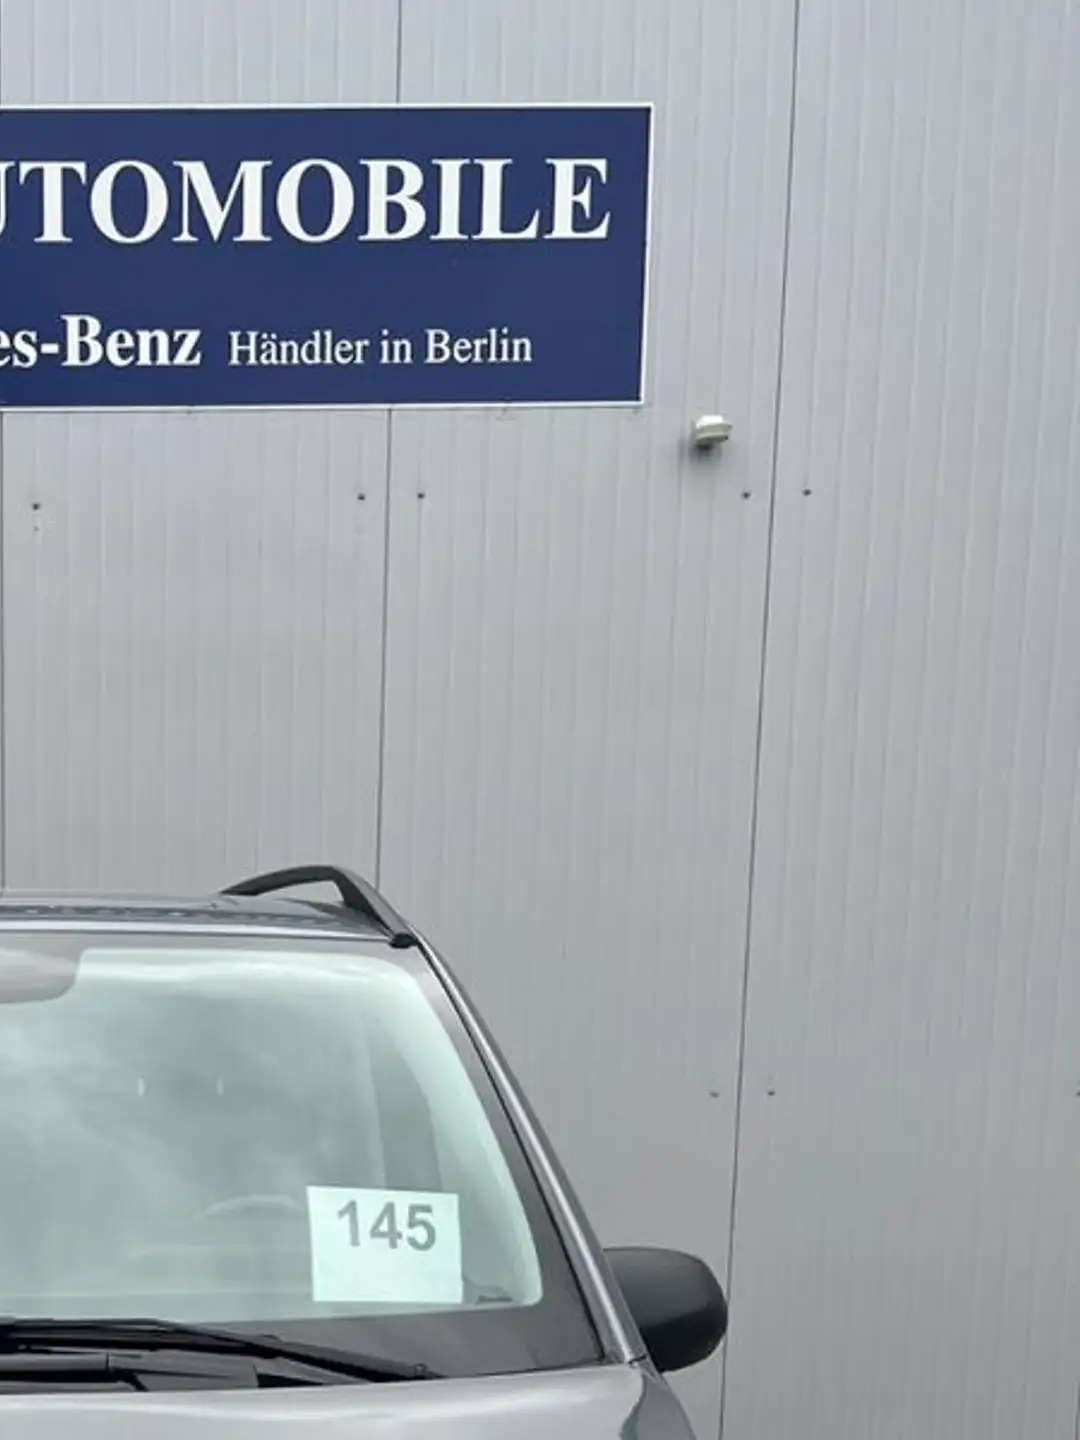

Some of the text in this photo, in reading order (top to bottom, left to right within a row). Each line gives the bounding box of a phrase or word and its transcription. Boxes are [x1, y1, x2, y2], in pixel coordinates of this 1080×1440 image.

[228, 328, 369, 367] Händler
[380, 328, 413, 365] in
[424, 328, 533, 365] Berlin
[337, 1199, 436, 1251] 145
